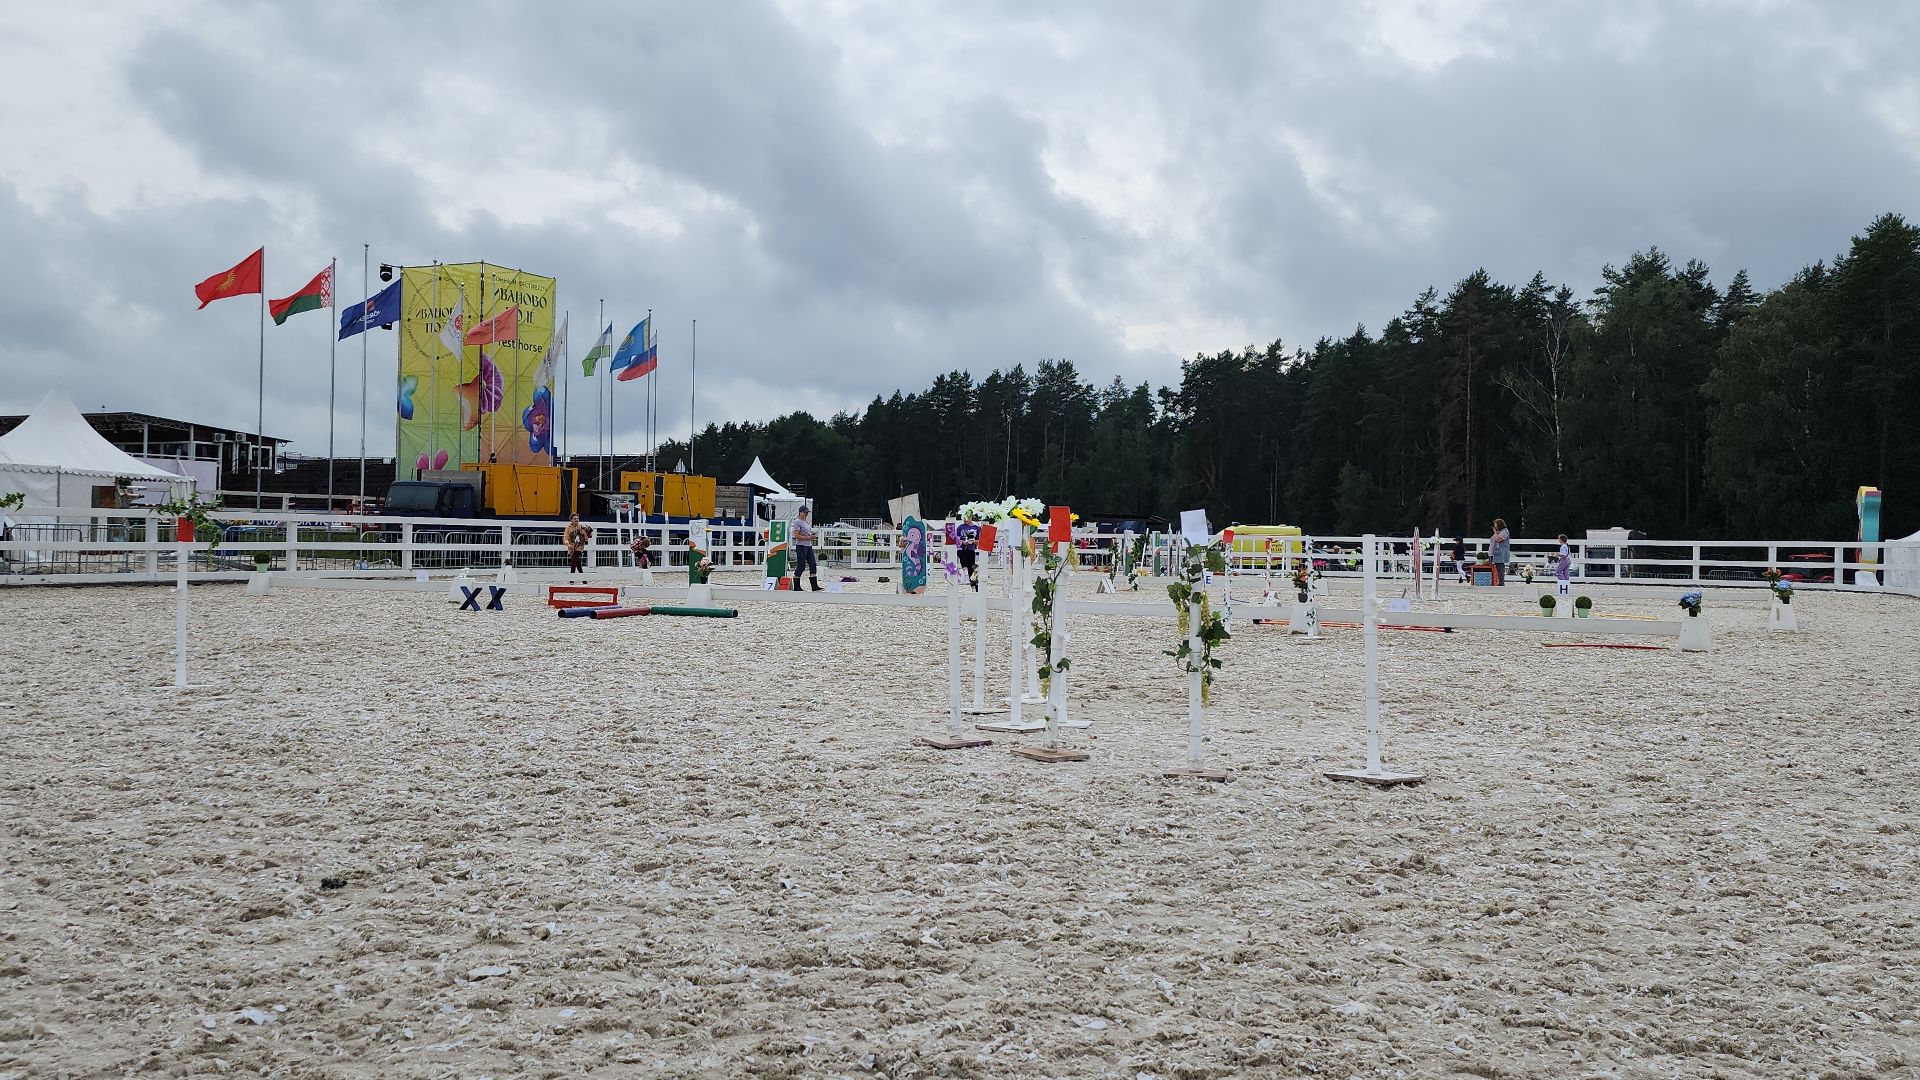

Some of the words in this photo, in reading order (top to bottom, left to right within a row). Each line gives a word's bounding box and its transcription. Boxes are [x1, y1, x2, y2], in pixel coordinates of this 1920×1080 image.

[495, 276, 517, 286] ОННЫЙ
[518, 338, 543, 353] horse
[1205, 576, 1211, 584] E
[1559, 585, 1568, 594] H
